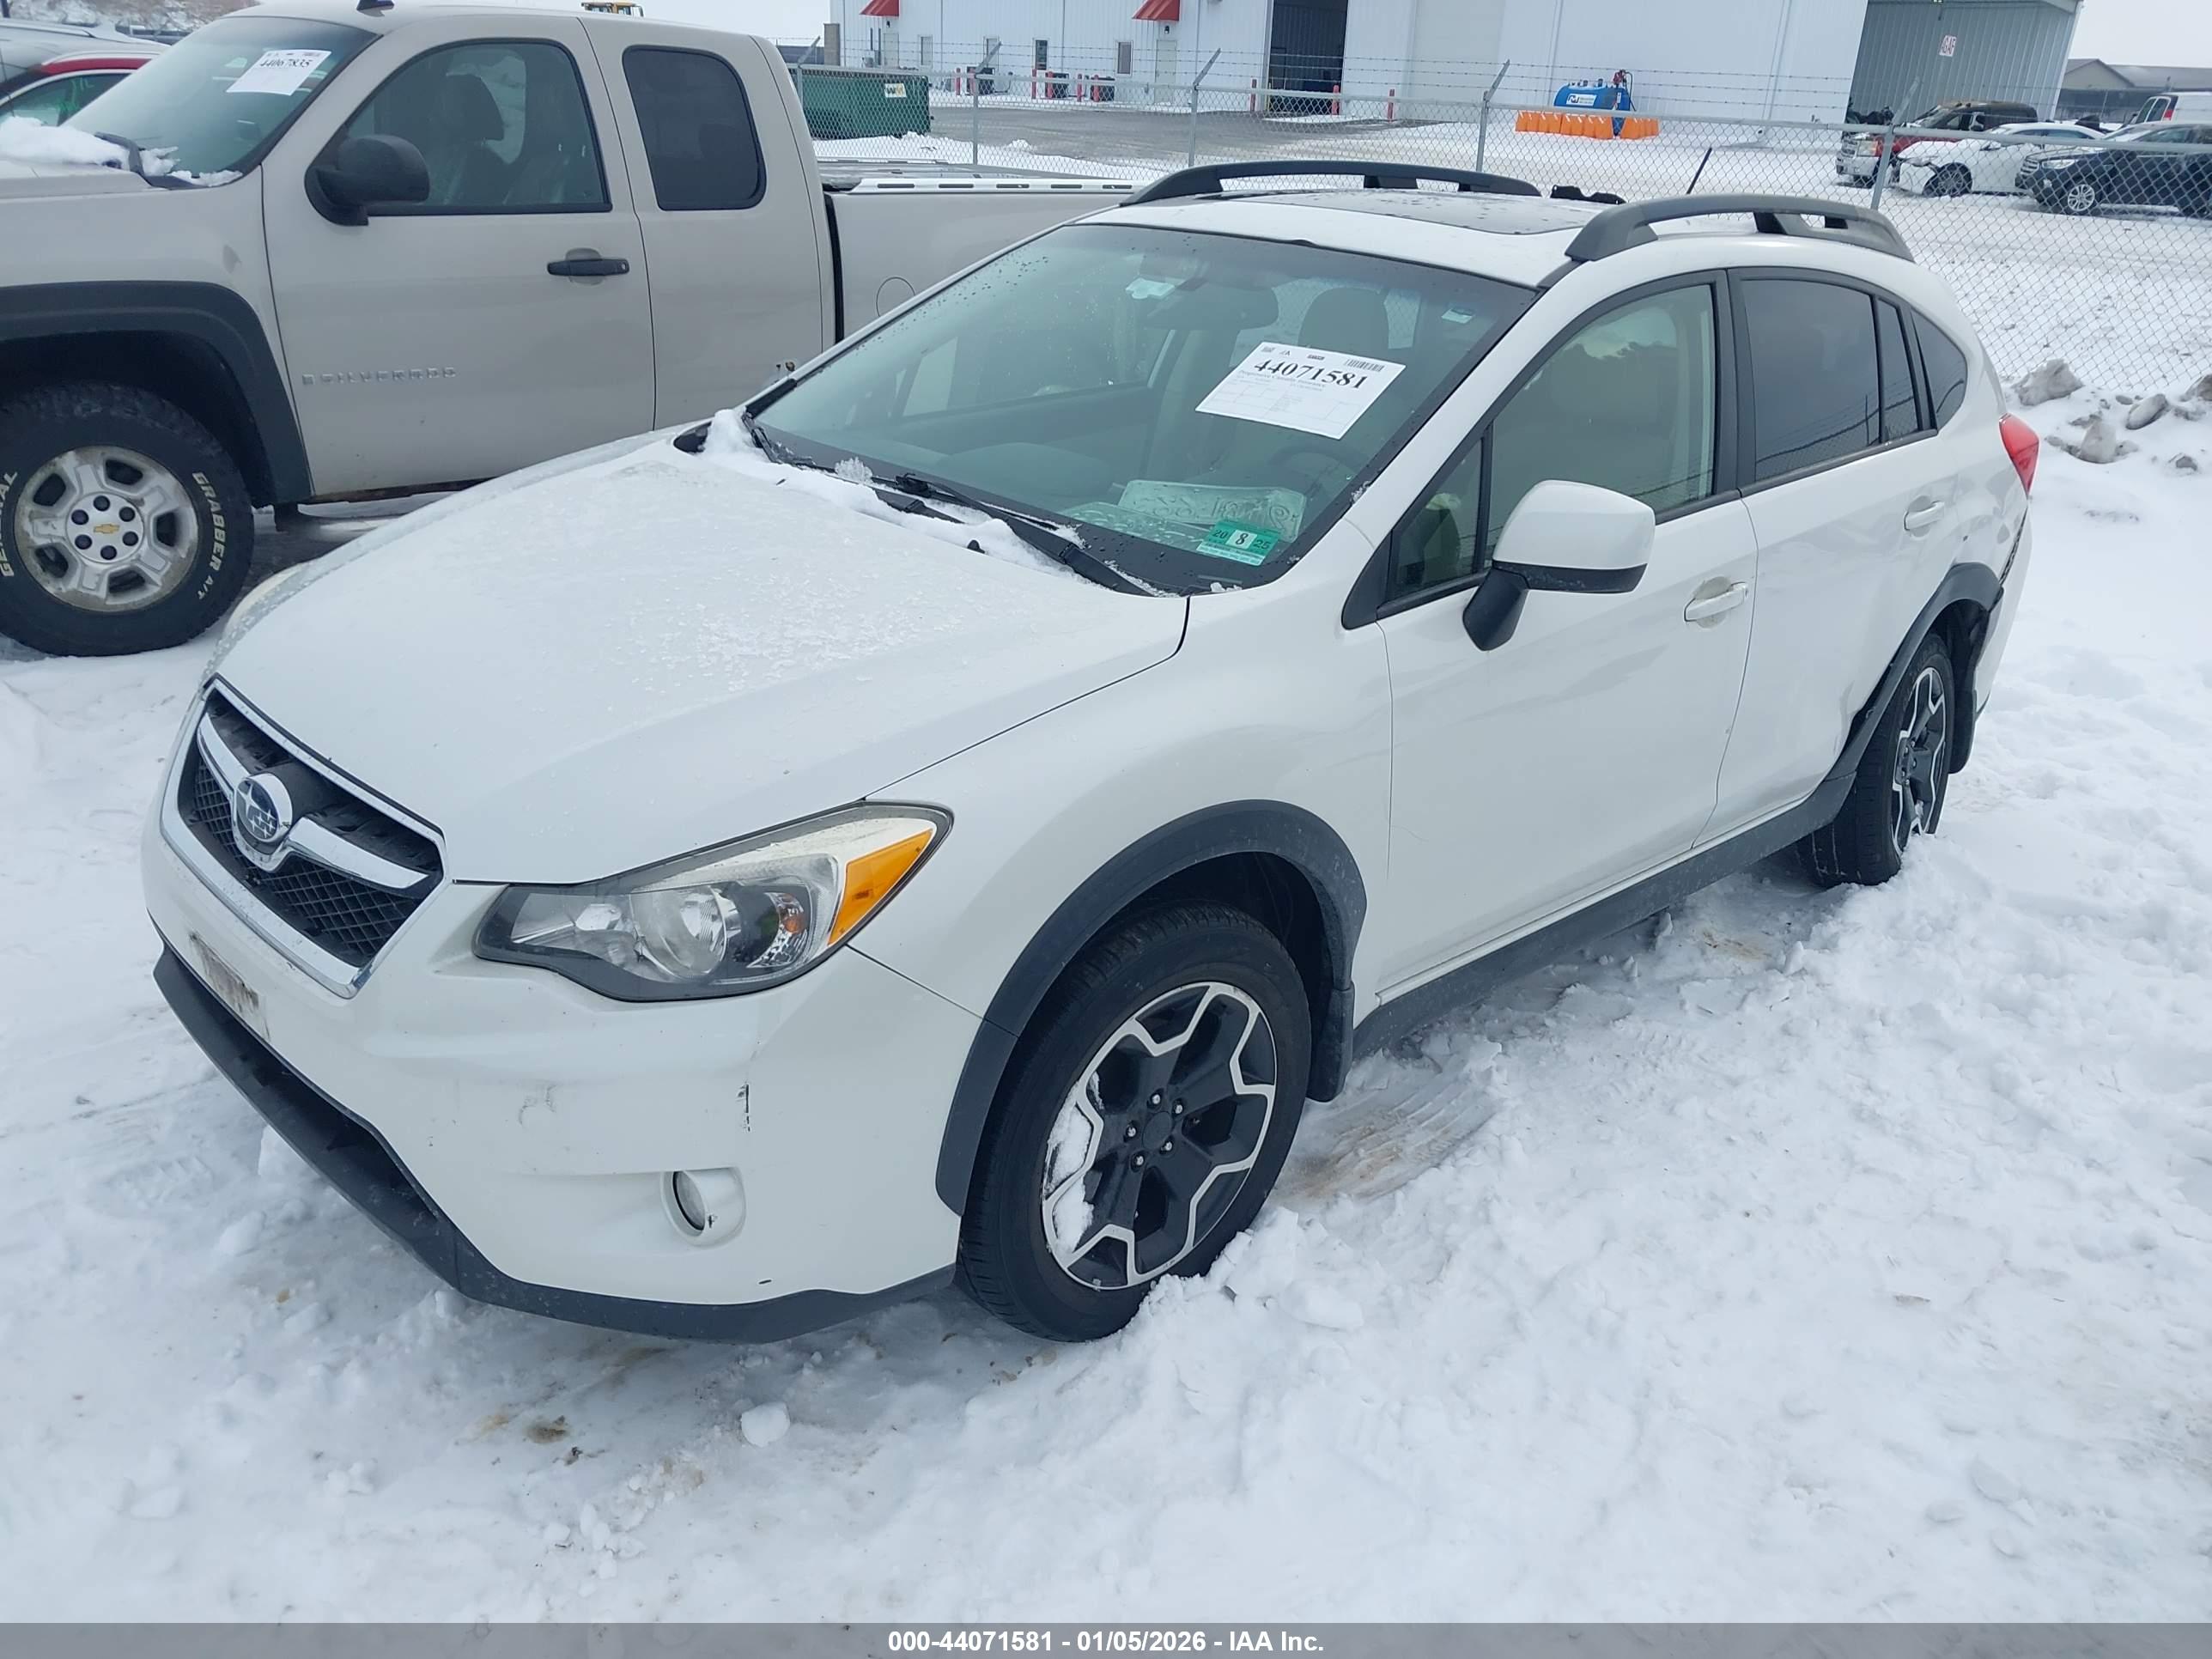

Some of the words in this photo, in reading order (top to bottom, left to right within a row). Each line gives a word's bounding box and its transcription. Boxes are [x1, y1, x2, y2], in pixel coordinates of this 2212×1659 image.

[320, 367, 457, 384] SILVERADO
[1253, 358, 1369, 389] 44071581
[192, 471, 226, 571] GRABBER
[1212, 530, 1228, 539] 20
[1235, 532, 1249, 545] 8
[1253, 539, 1272, 550] 25
[198, 574, 214, 599] A/T
